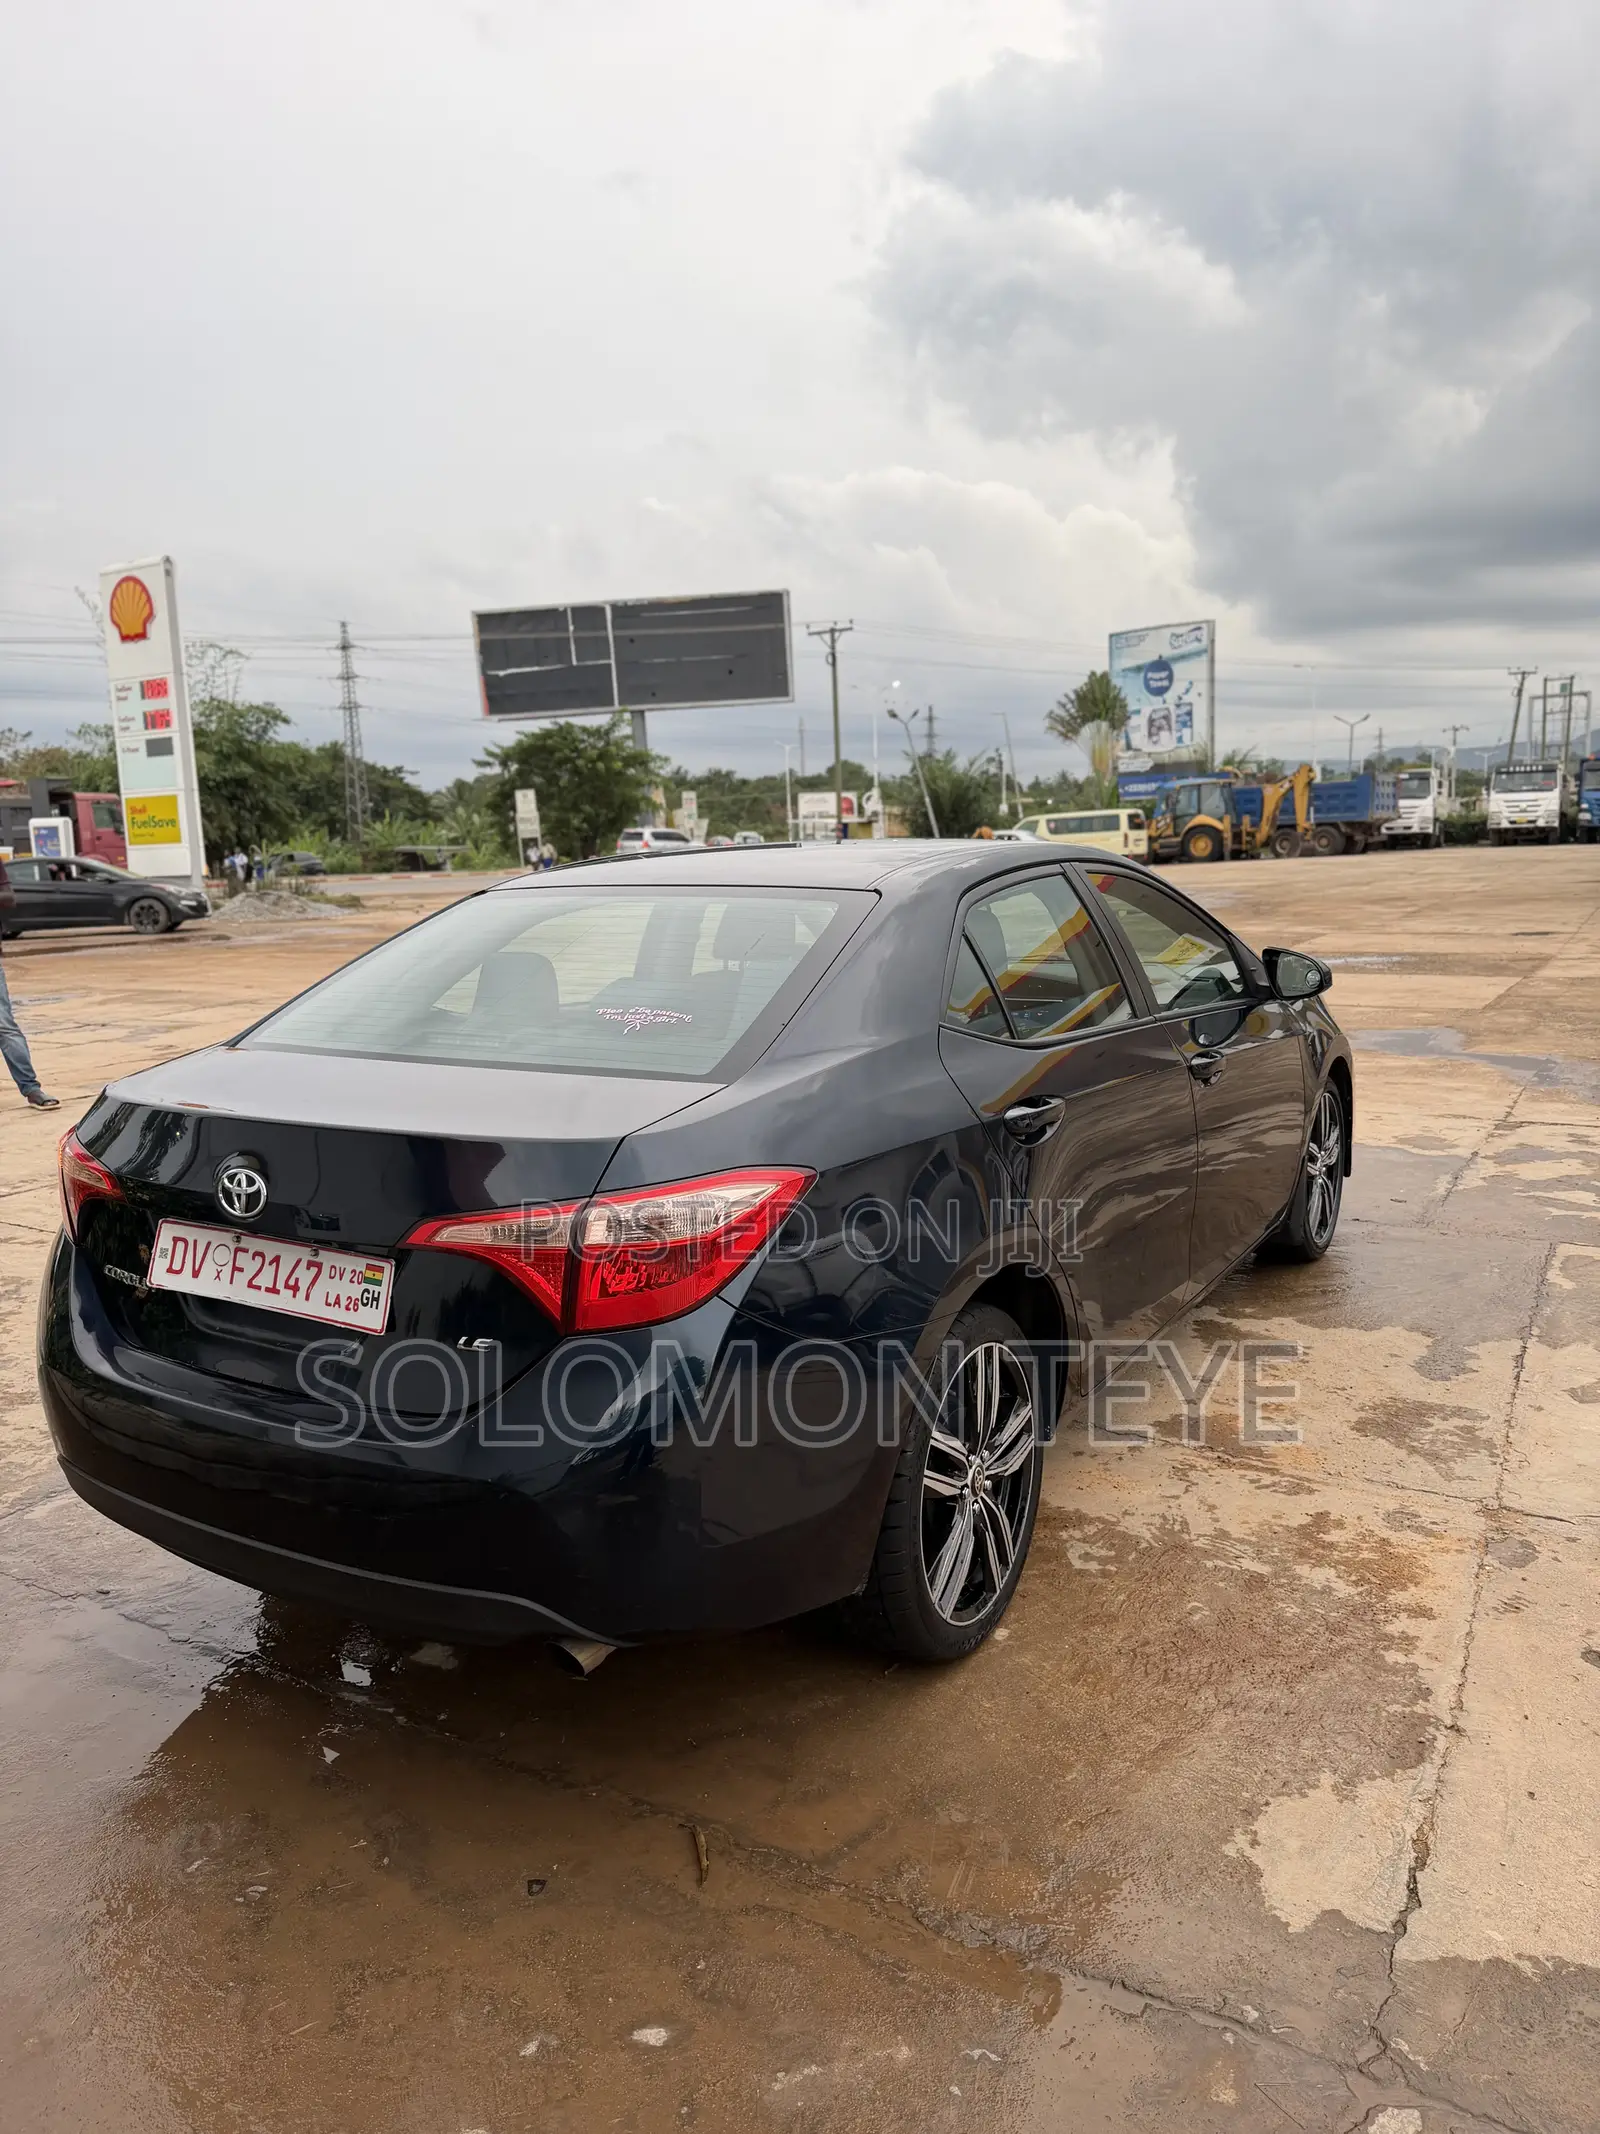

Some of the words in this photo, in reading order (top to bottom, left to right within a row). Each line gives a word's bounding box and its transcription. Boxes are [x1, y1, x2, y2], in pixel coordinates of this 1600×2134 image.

[131, 814, 176, 830] FuelSave
[104, 1264, 153, 1291] COROLL
[166, 1236, 212, 1279] DV
[229, 1246, 323, 1302] F2147
[328, 1264, 347, 1282] DV
[349, 1268, 364, 1286] 20
[325, 1291, 341, 1309] LA
[344, 1295, 360, 1312] 26
[360, 1287, 381, 1310] GH
[457, 1336, 493, 1352] LE
